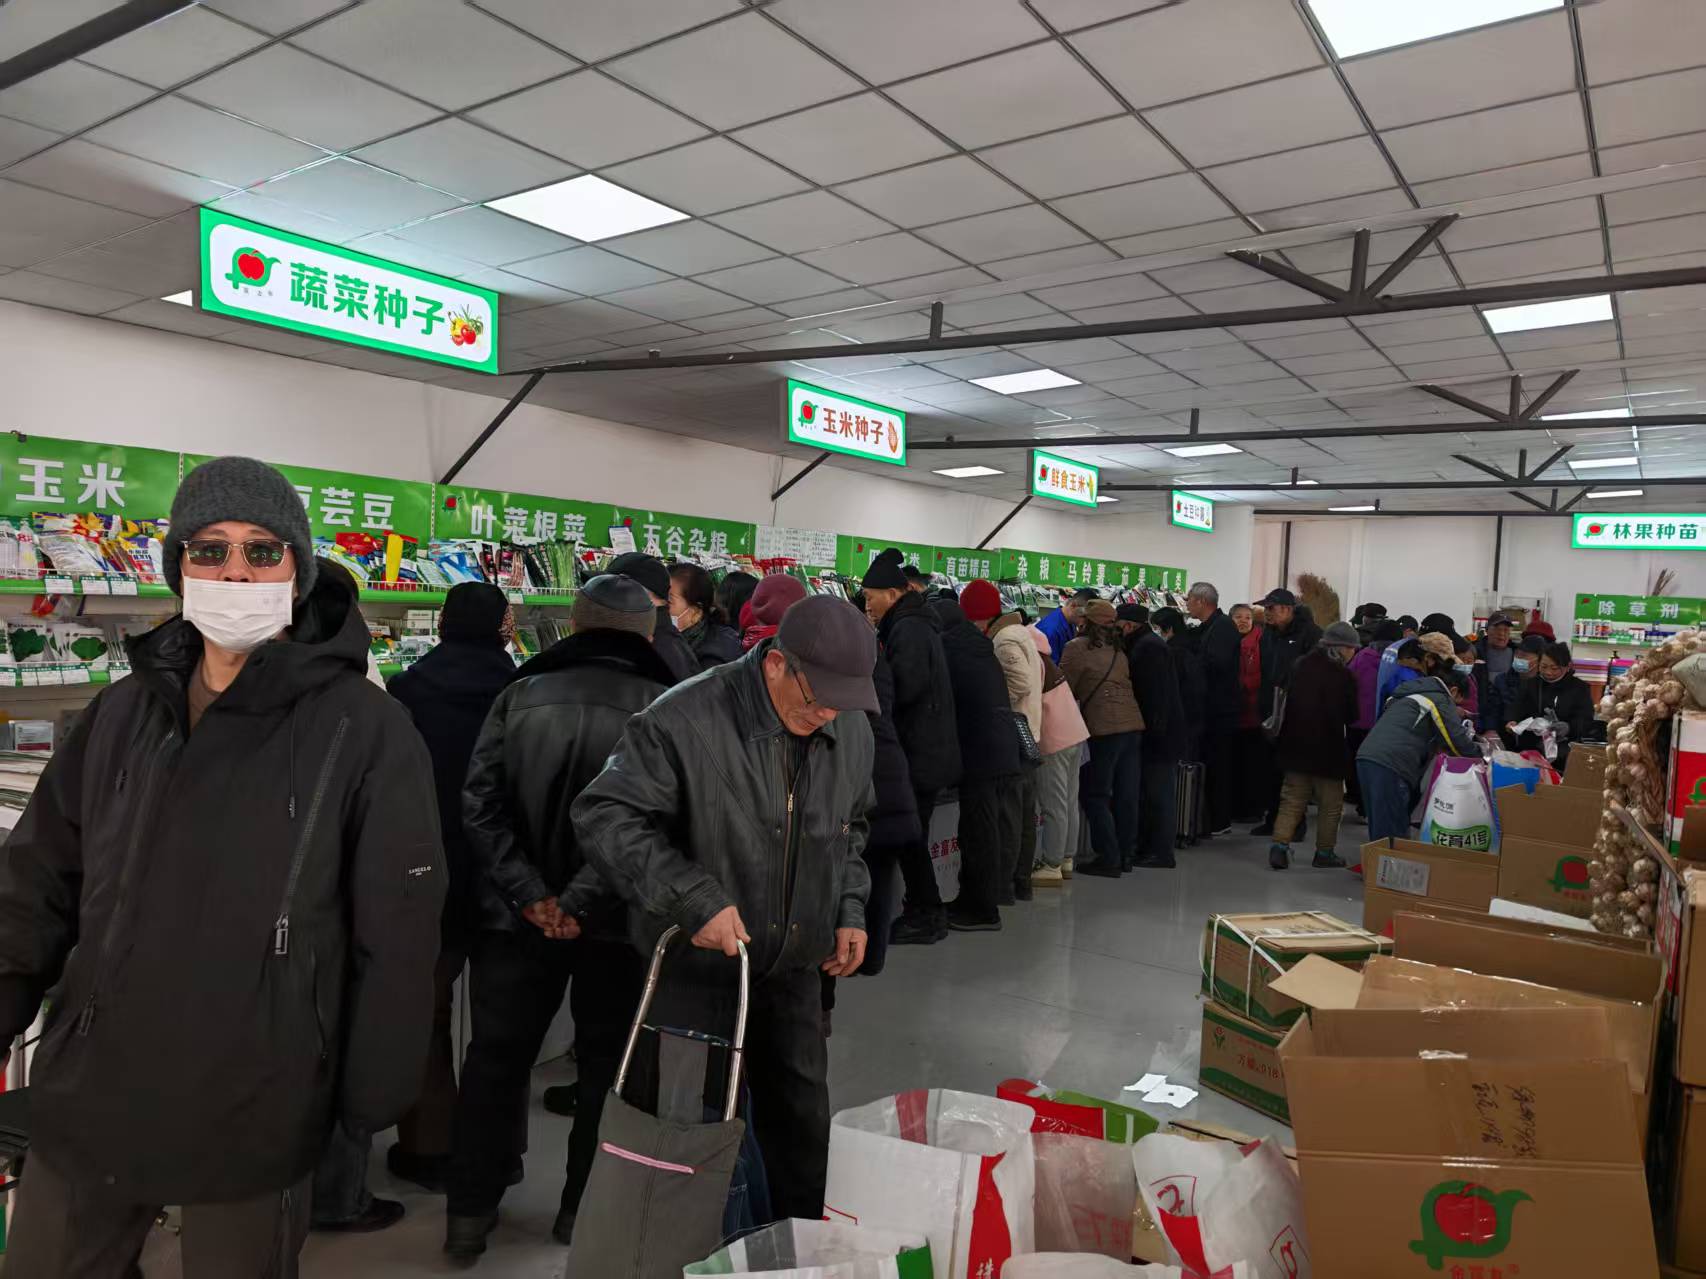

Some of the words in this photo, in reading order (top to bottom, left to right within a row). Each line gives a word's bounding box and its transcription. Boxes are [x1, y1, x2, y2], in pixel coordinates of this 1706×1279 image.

[290, 262, 445, 335] 蔬菜种子
[823, 407, 884, 444] 玉米种子
[0, 457, 125, 509] 玉米
[1052, 467, 1085, 494] 鲜食玉米
[471, 504, 587, 545] 叶菜根菜
[643, 523, 729, 556] 五谷杂粮
[1613, 523, 1699, 540] 林果种苗
[1067, 560, 1106, 585] 马铃薯
[1598, 601, 1679, 619] 除草剂
